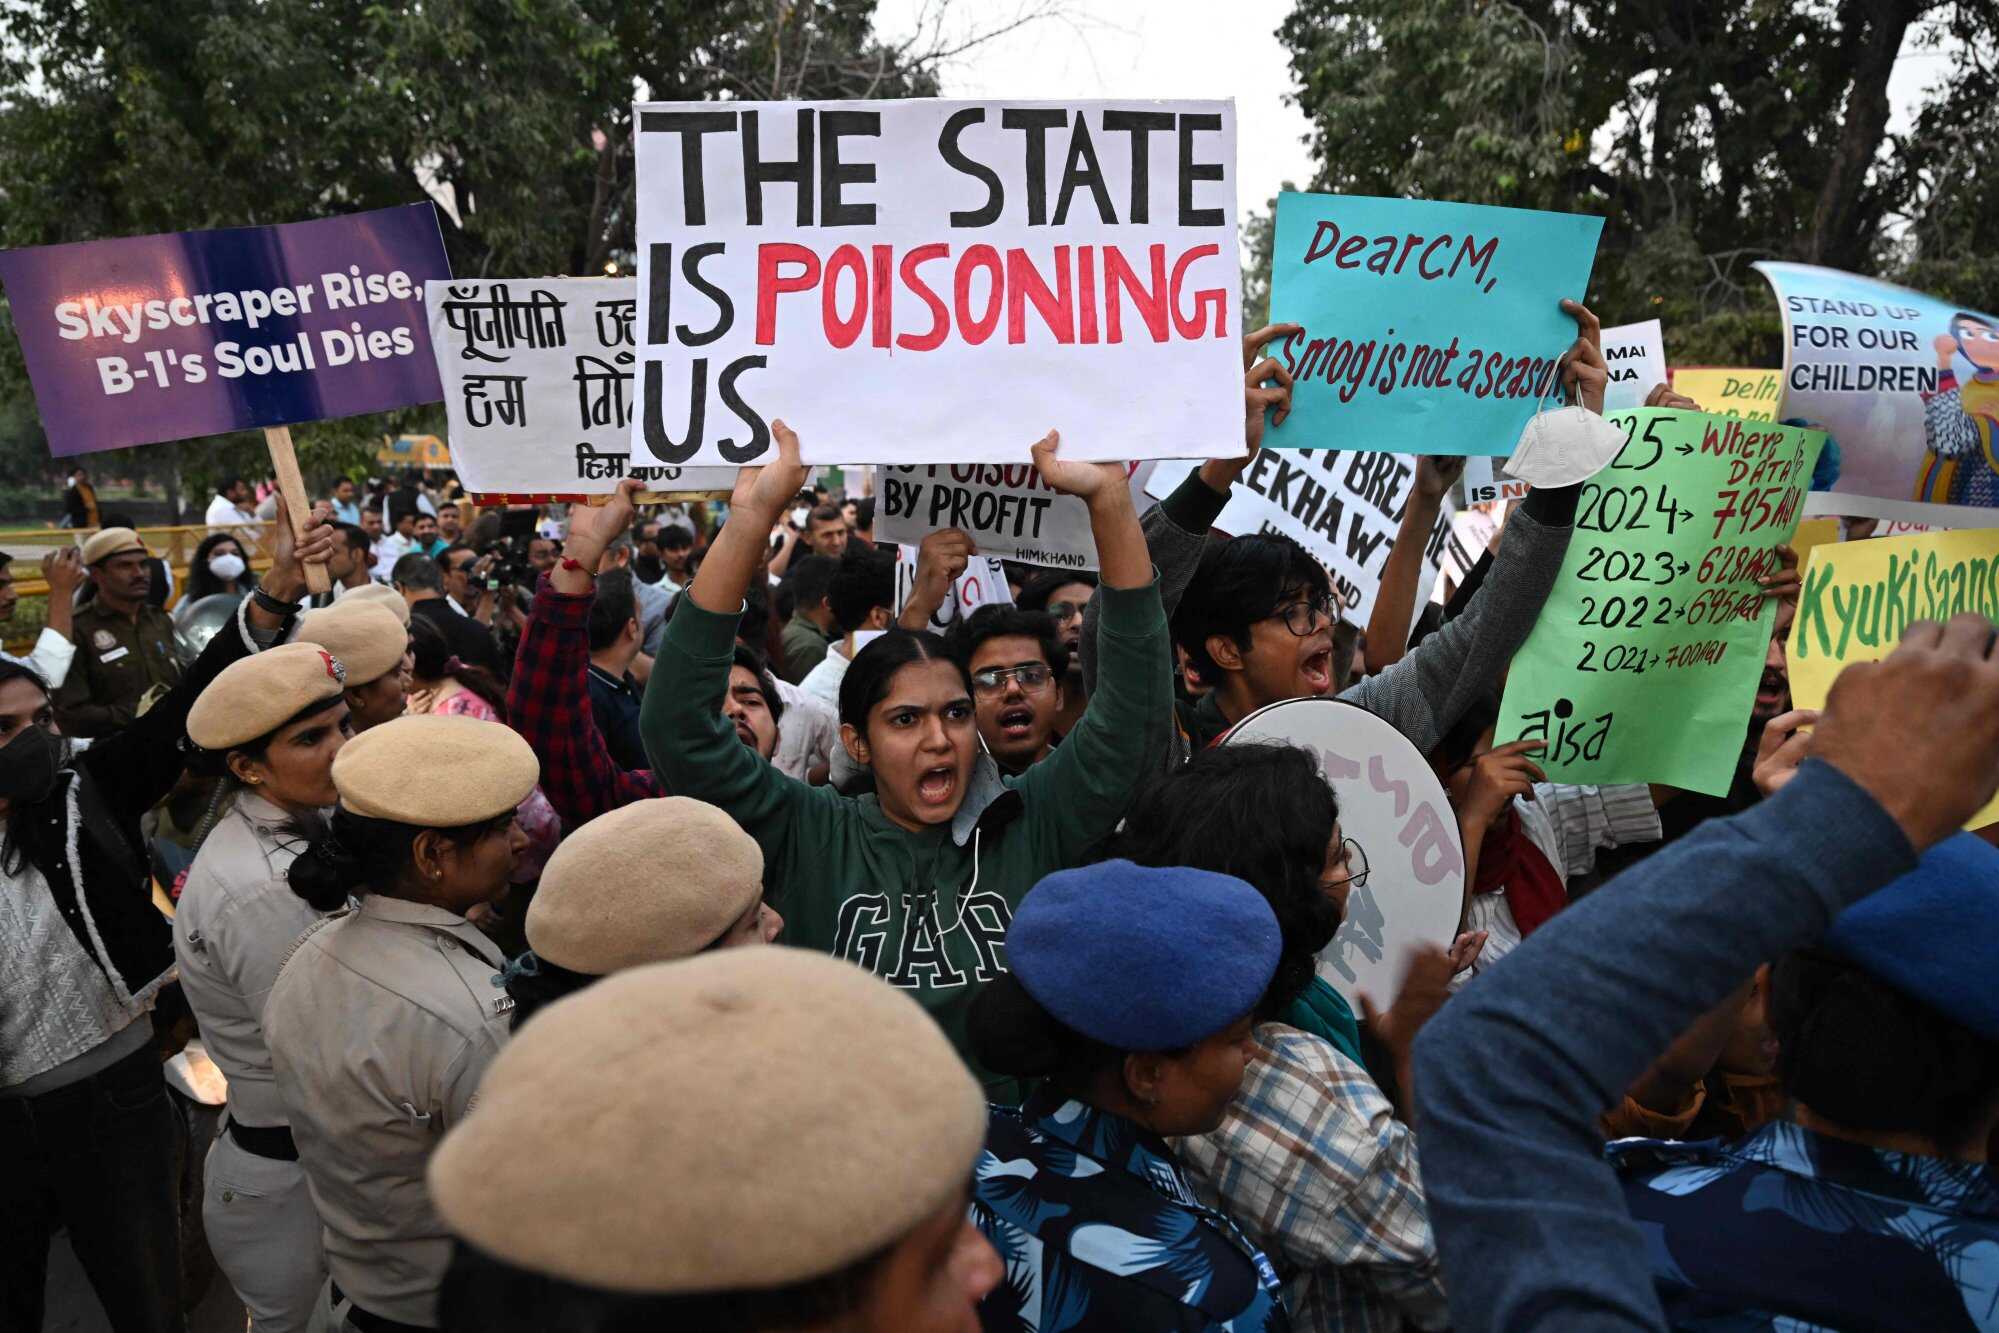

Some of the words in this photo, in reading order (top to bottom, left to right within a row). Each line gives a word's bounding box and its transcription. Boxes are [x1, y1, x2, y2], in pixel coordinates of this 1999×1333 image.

[640, 108, 881, 227] THE
[938, 107, 1225, 227] STATE
[54, 283, 314, 344] Skyscraper
[321, 264, 424, 310] Rise,
[647, 242, 734, 348] IS
[755, 242, 1227, 353] POISONING
[1787, 296, 1878, 318] STAND
[1884, 305, 1921, 320] UP
[1606, 346, 1646, 360] MAI
[1792, 324, 1849, 349] FOR
[1858, 328, 1920, 351] OUR
[97, 349, 207, 396] B-1's
[214, 333, 315, 378] Soul
[321, 323, 415, 367] Dies
[1790, 364, 1937, 392] CHILDREN
[462, 375, 528, 427] हम
[1721, 376, 1780, 401] Delh
[643, 355, 770, 464] US
[1701, 421, 1784, 460] Where
[1343, 451, 1412, 524] BRE
[1471, 486, 1497, 501] IS
[884, 478, 923, 519] BY
[929, 484, 1052, 538] PROFIT
[1576, 483, 1678, 534] 2024
[1016, 547, 1086, 567] HIMKHAND
[1577, 547, 1675, 584] 2023
[1578, 595, 1672, 628] 2022
[1576, 641, 1649, 673] 2021
[832, 888, 1013, 989] GAP
